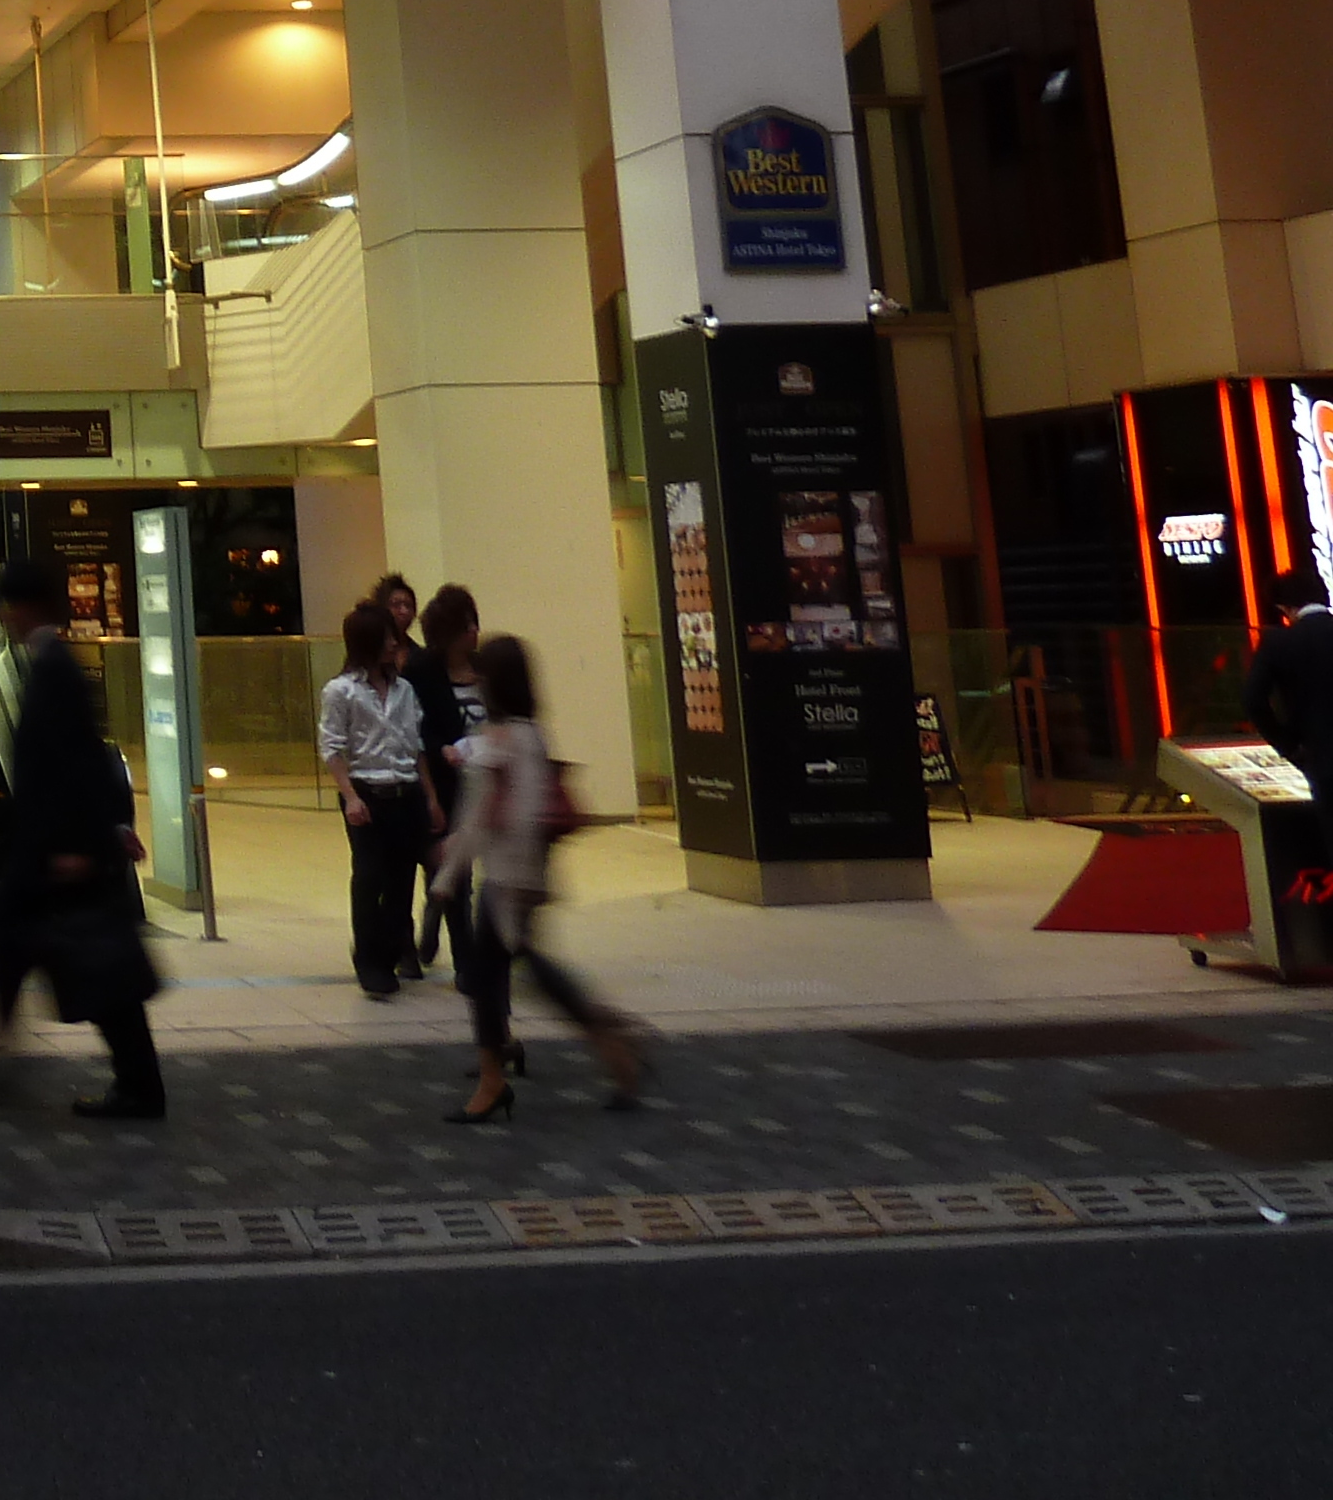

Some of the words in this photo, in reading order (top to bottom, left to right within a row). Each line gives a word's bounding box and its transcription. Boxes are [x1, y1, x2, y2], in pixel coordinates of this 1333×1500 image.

[746, 148, 801, 173] Best
[727, 169, 829, 195] Western
[775, 243, 804, 257] Hotel
[806, 243, 837, 258] Tokyo
[803, 703, 859, 723] Stella
